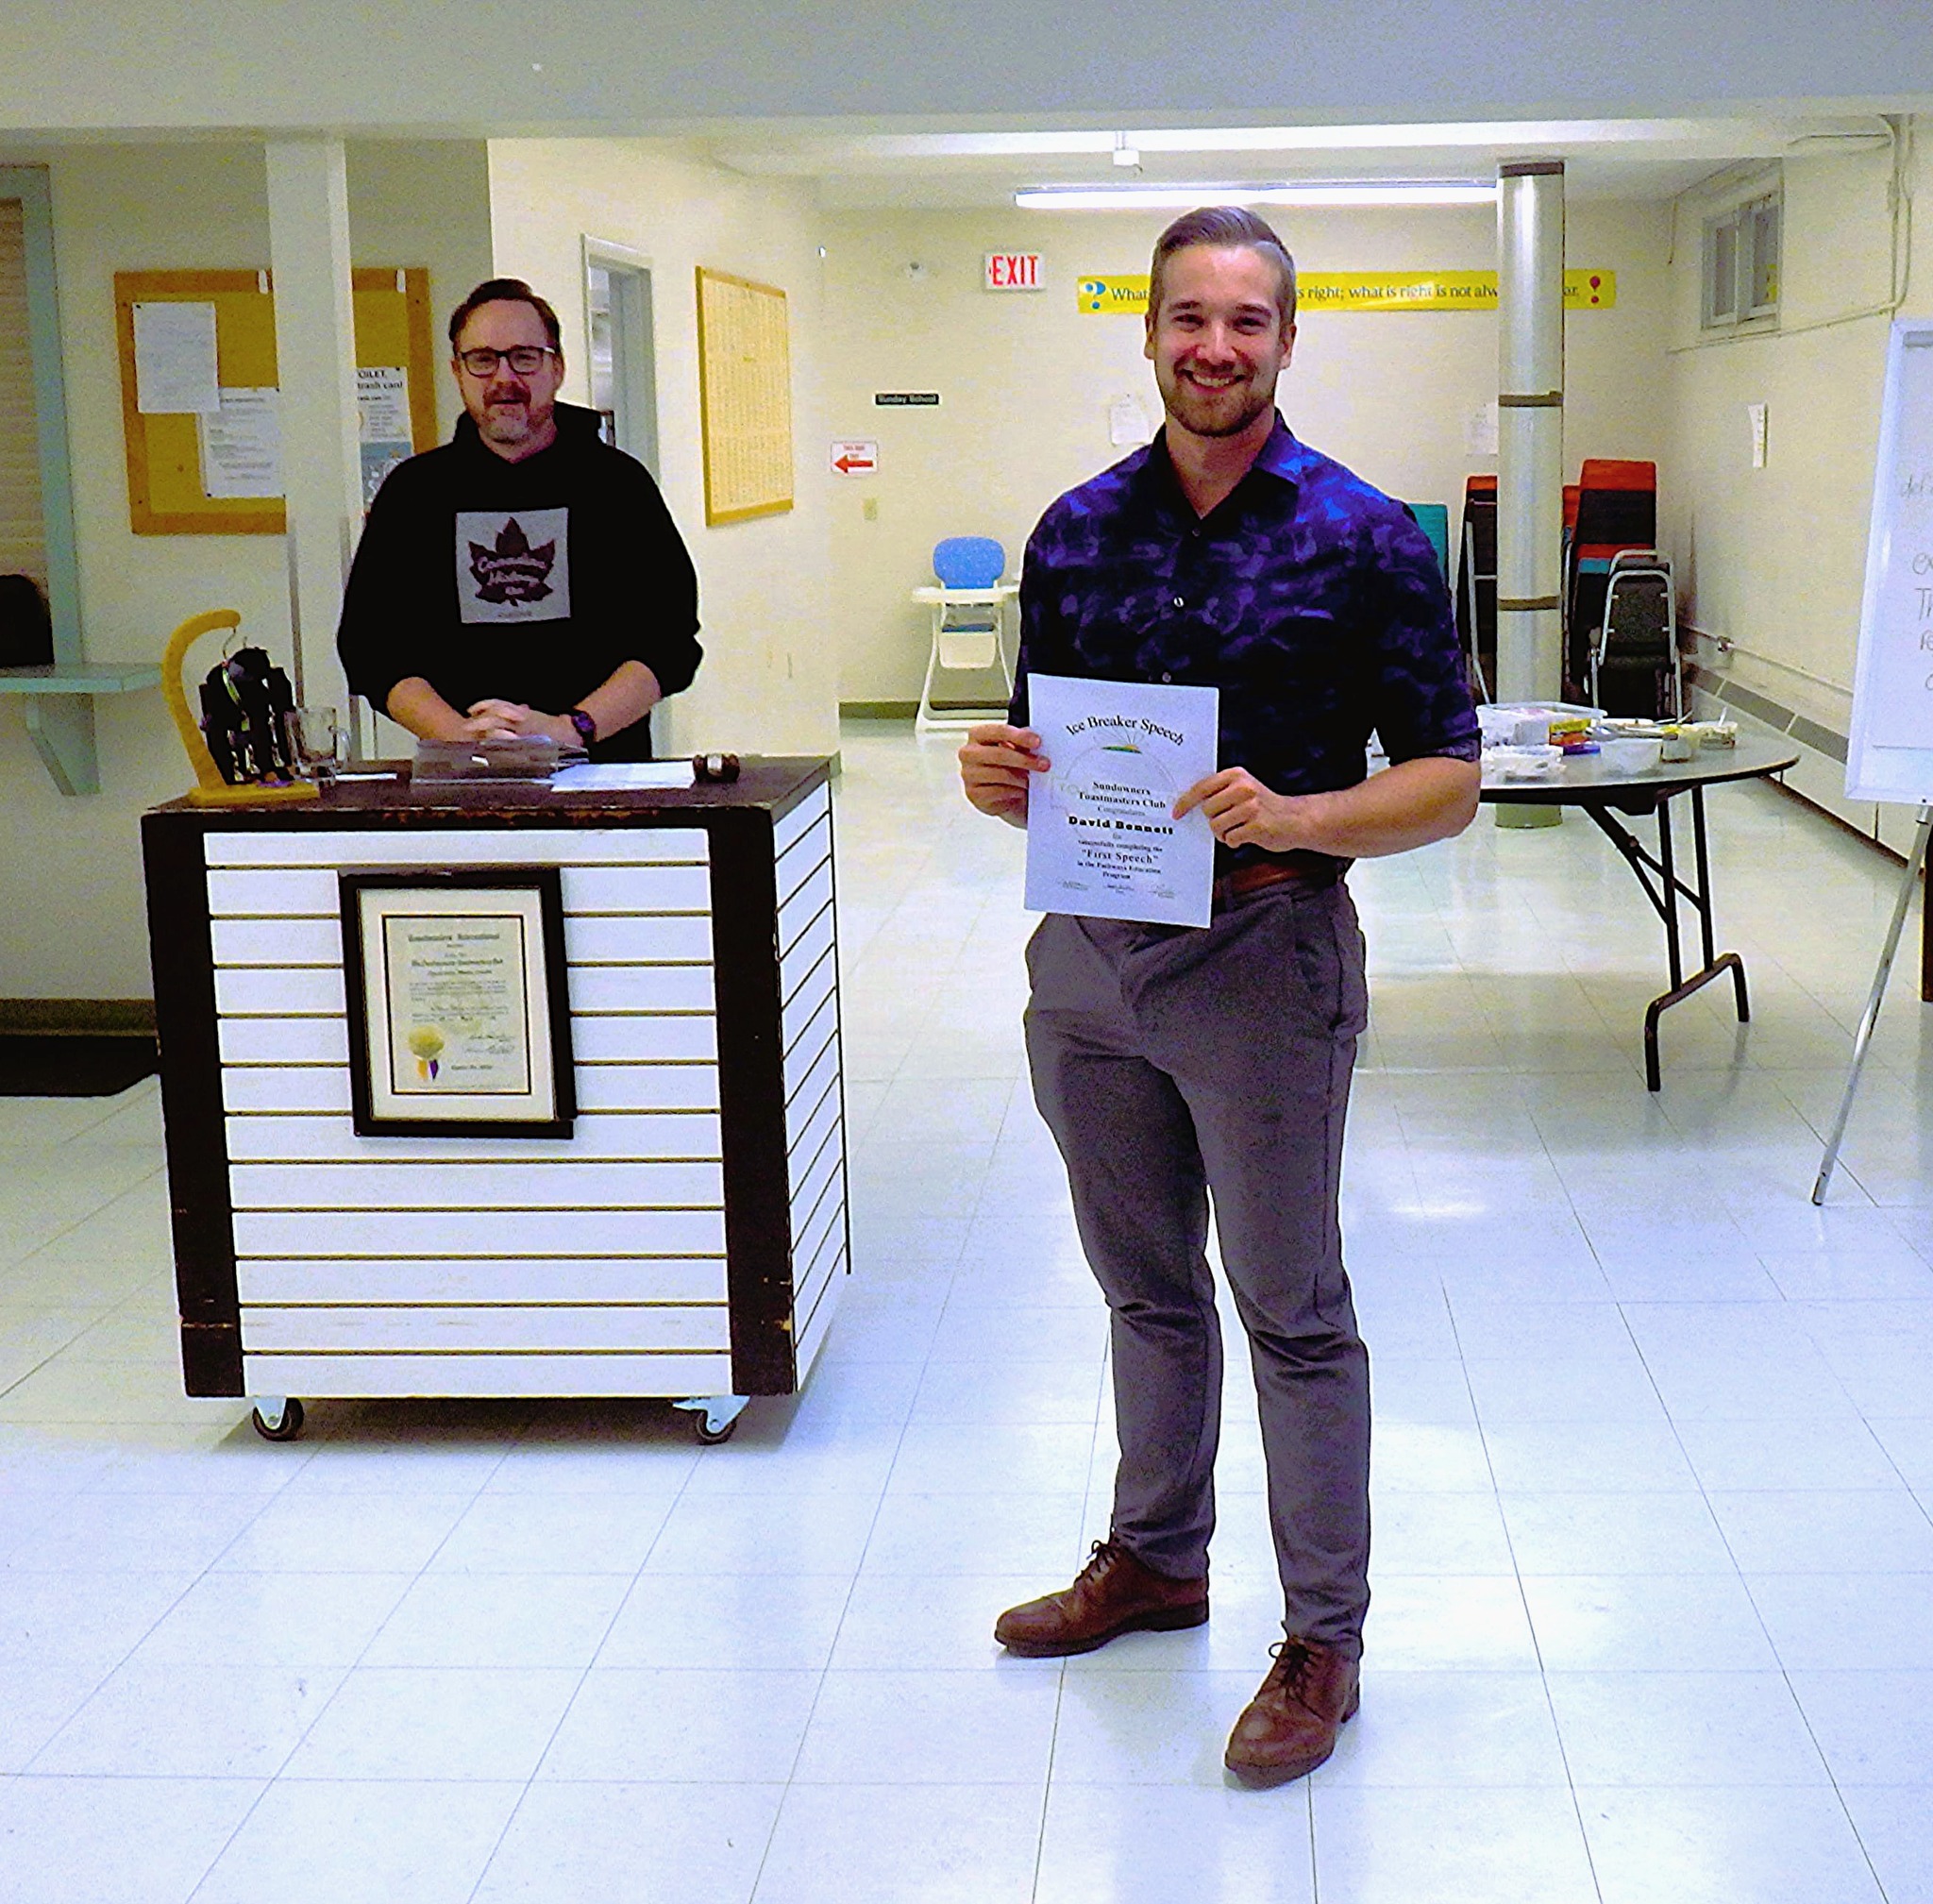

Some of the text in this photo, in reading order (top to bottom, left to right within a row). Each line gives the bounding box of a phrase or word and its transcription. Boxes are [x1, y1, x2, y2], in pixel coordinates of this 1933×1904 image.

[992, 255, 1038, 285] EXIT
[1111, 287, 1149, 301] What
[1308, 285, 1344, 302] right;
[1349, 286, 1383, 298] what
[1387, 284, 1397, 298] is
[1401, 284, 1432, 301] right
[1437, 284, 1448, 298] is
[1450, 285, 1471, 297] not
[1474, 283, 1498, 298] alw
[1066, 715, 1184, 746] Ice Breaker Speech
[1093, 782, 1151, 796] Sundowners
[1079, 791, 1166, 808] Toastmasters Club
[1068, 816, 1173, 834] David Bennett
